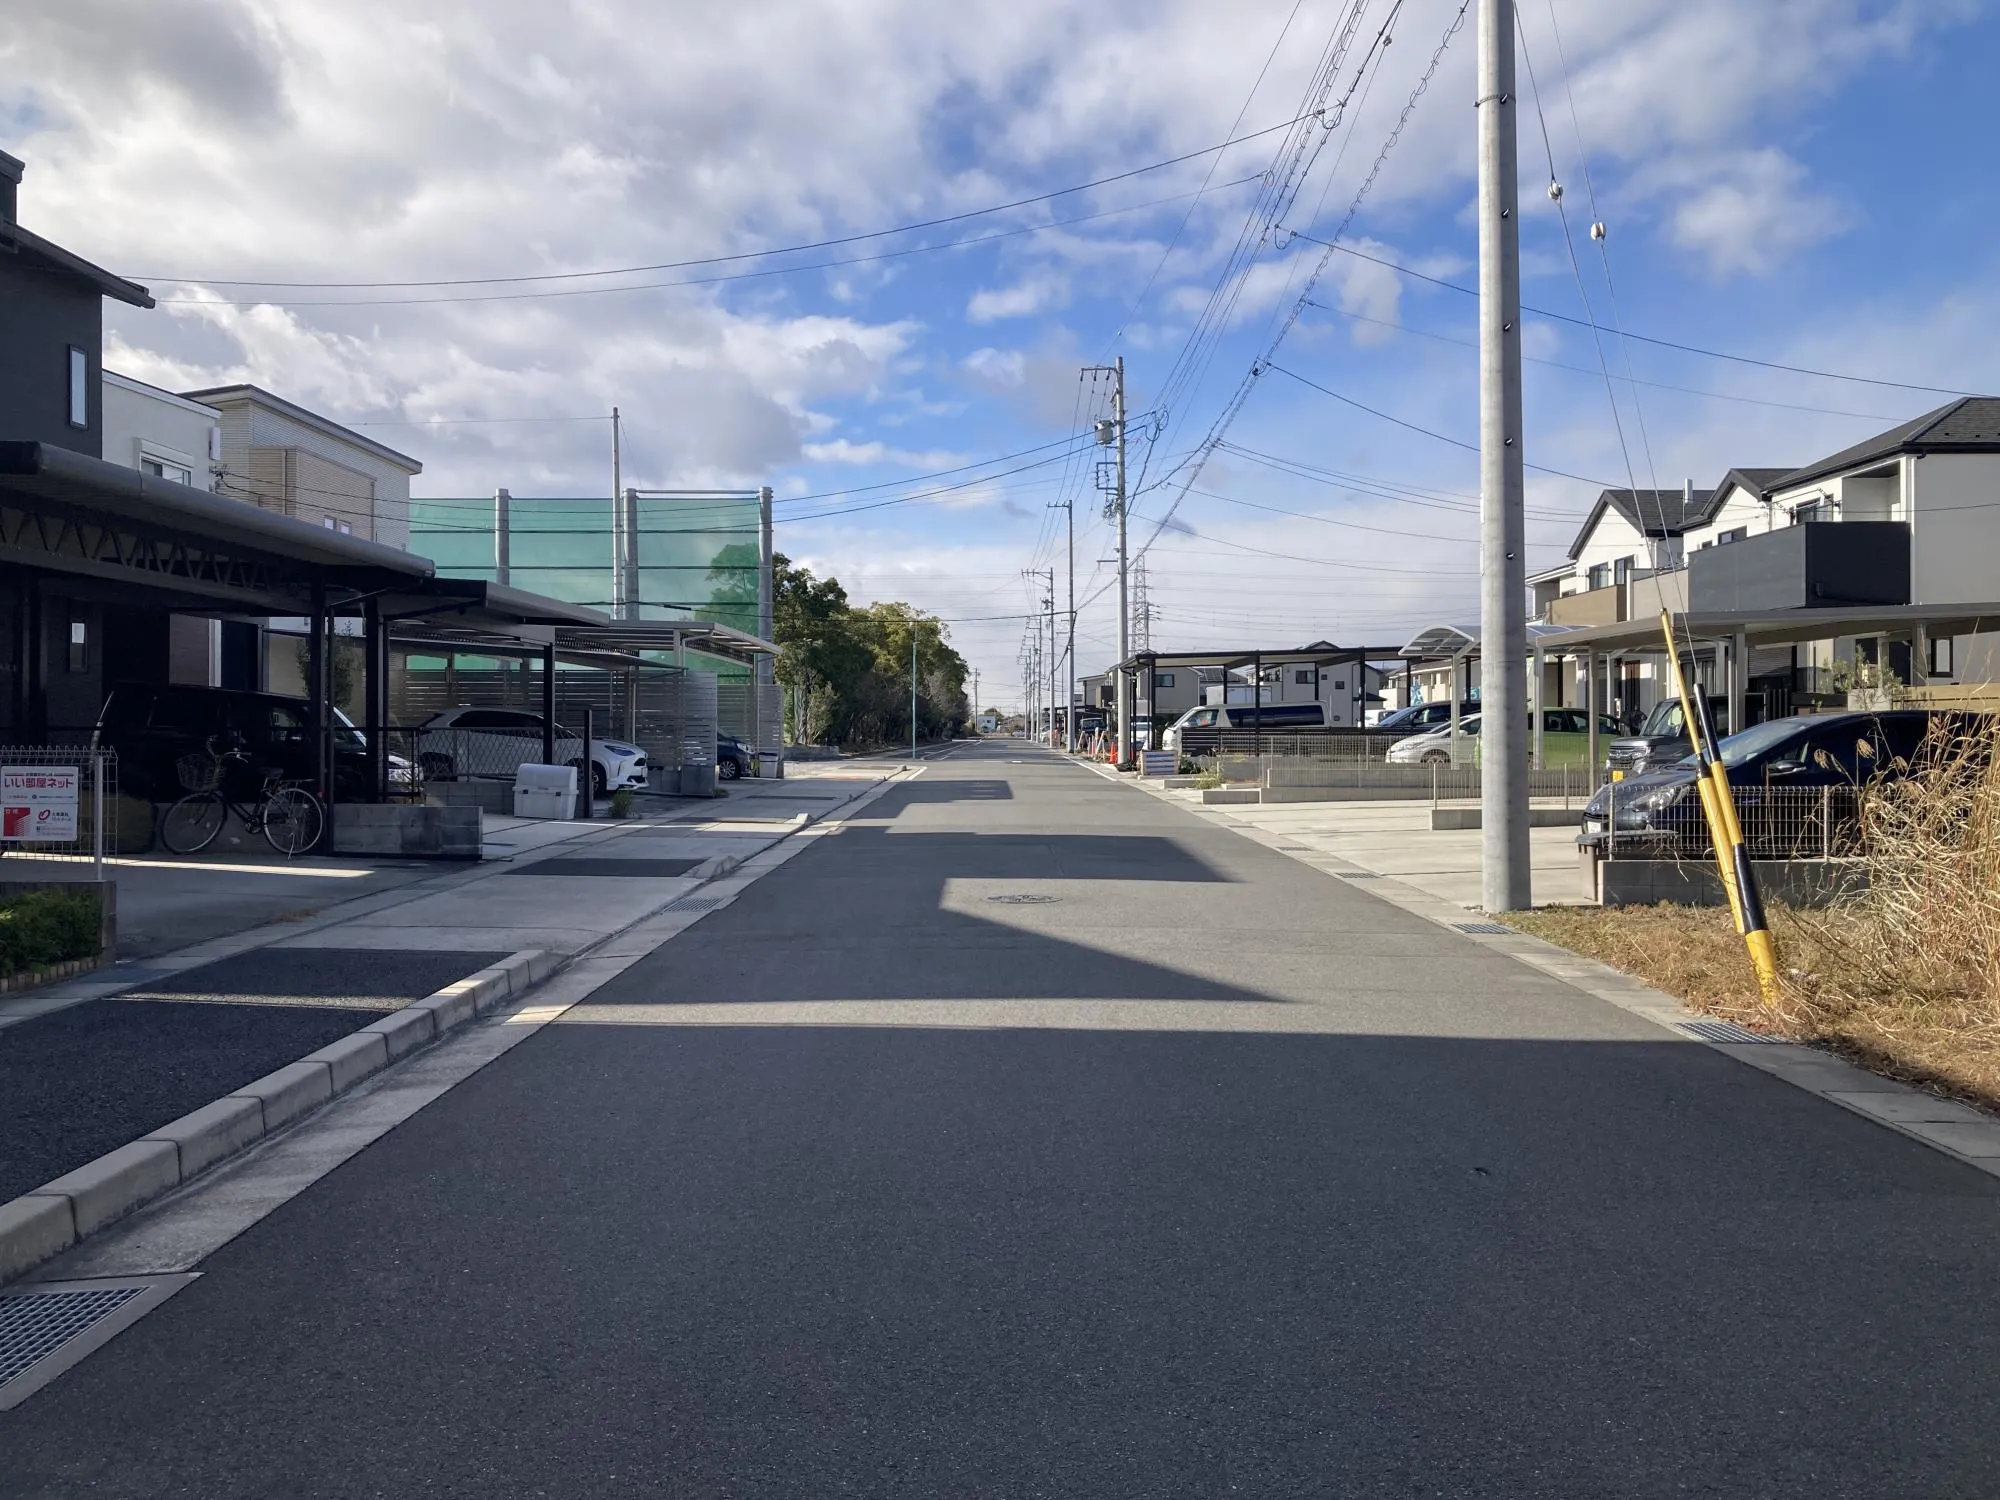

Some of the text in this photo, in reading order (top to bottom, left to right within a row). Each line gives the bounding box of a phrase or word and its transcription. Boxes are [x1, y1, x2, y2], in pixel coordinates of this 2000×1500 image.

[4, 777, 74, 788] いい部屋ネット
